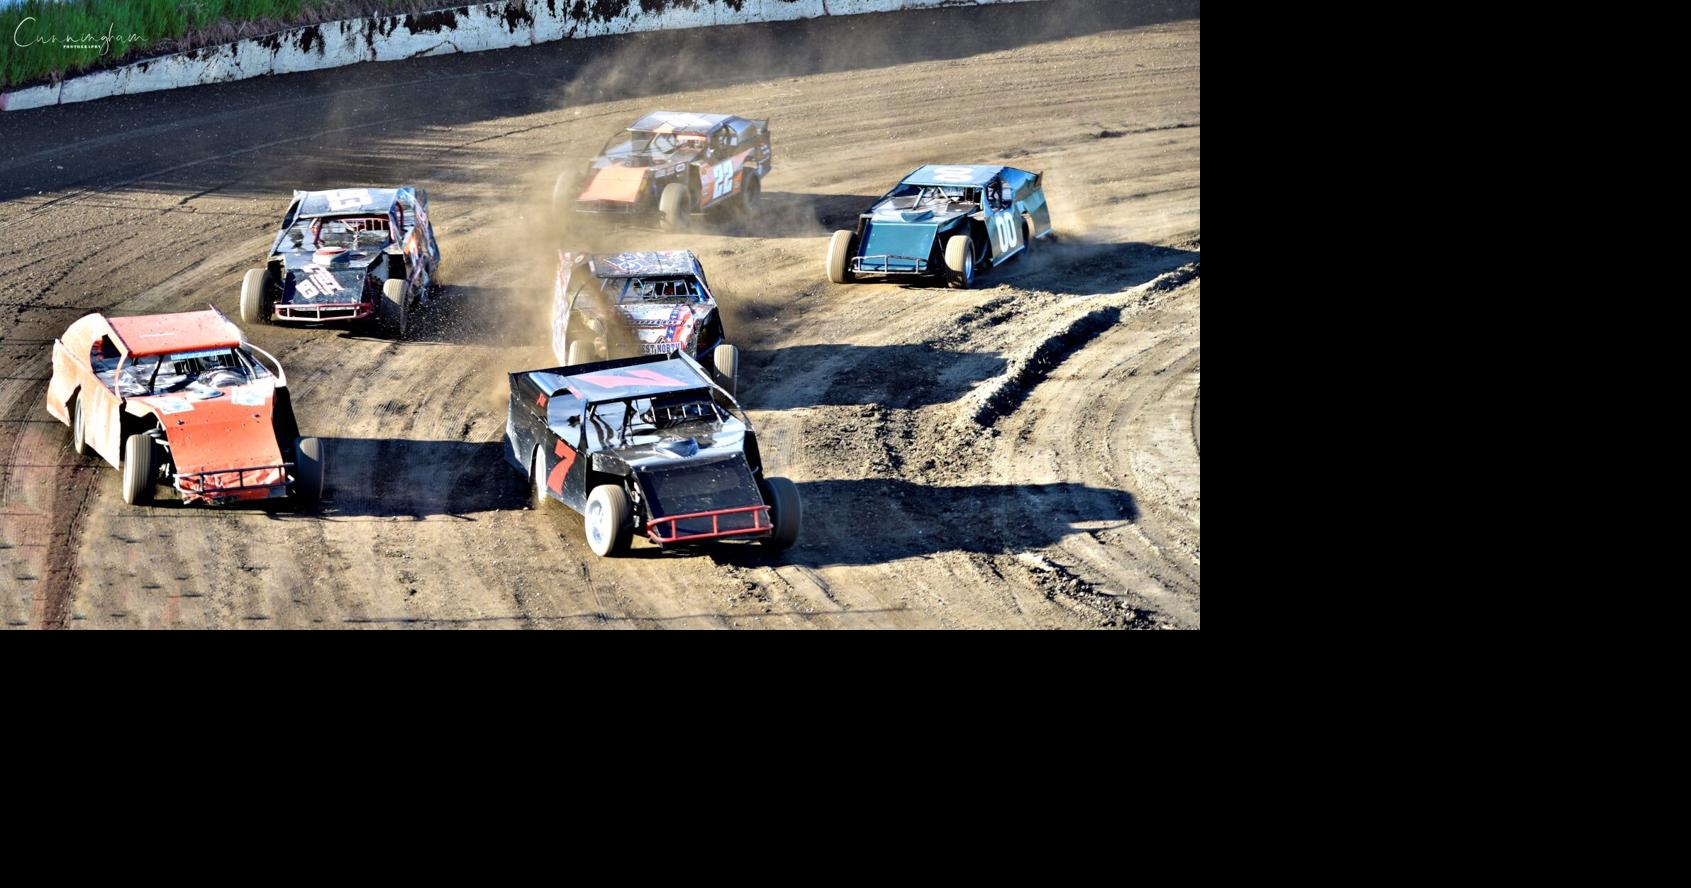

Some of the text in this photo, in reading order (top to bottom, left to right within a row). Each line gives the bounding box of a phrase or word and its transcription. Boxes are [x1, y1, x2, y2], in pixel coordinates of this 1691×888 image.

[712, 159, 734, 199] 22
[995, 212, 1018, 253] 00
[546, 439, 577, 496] 7
